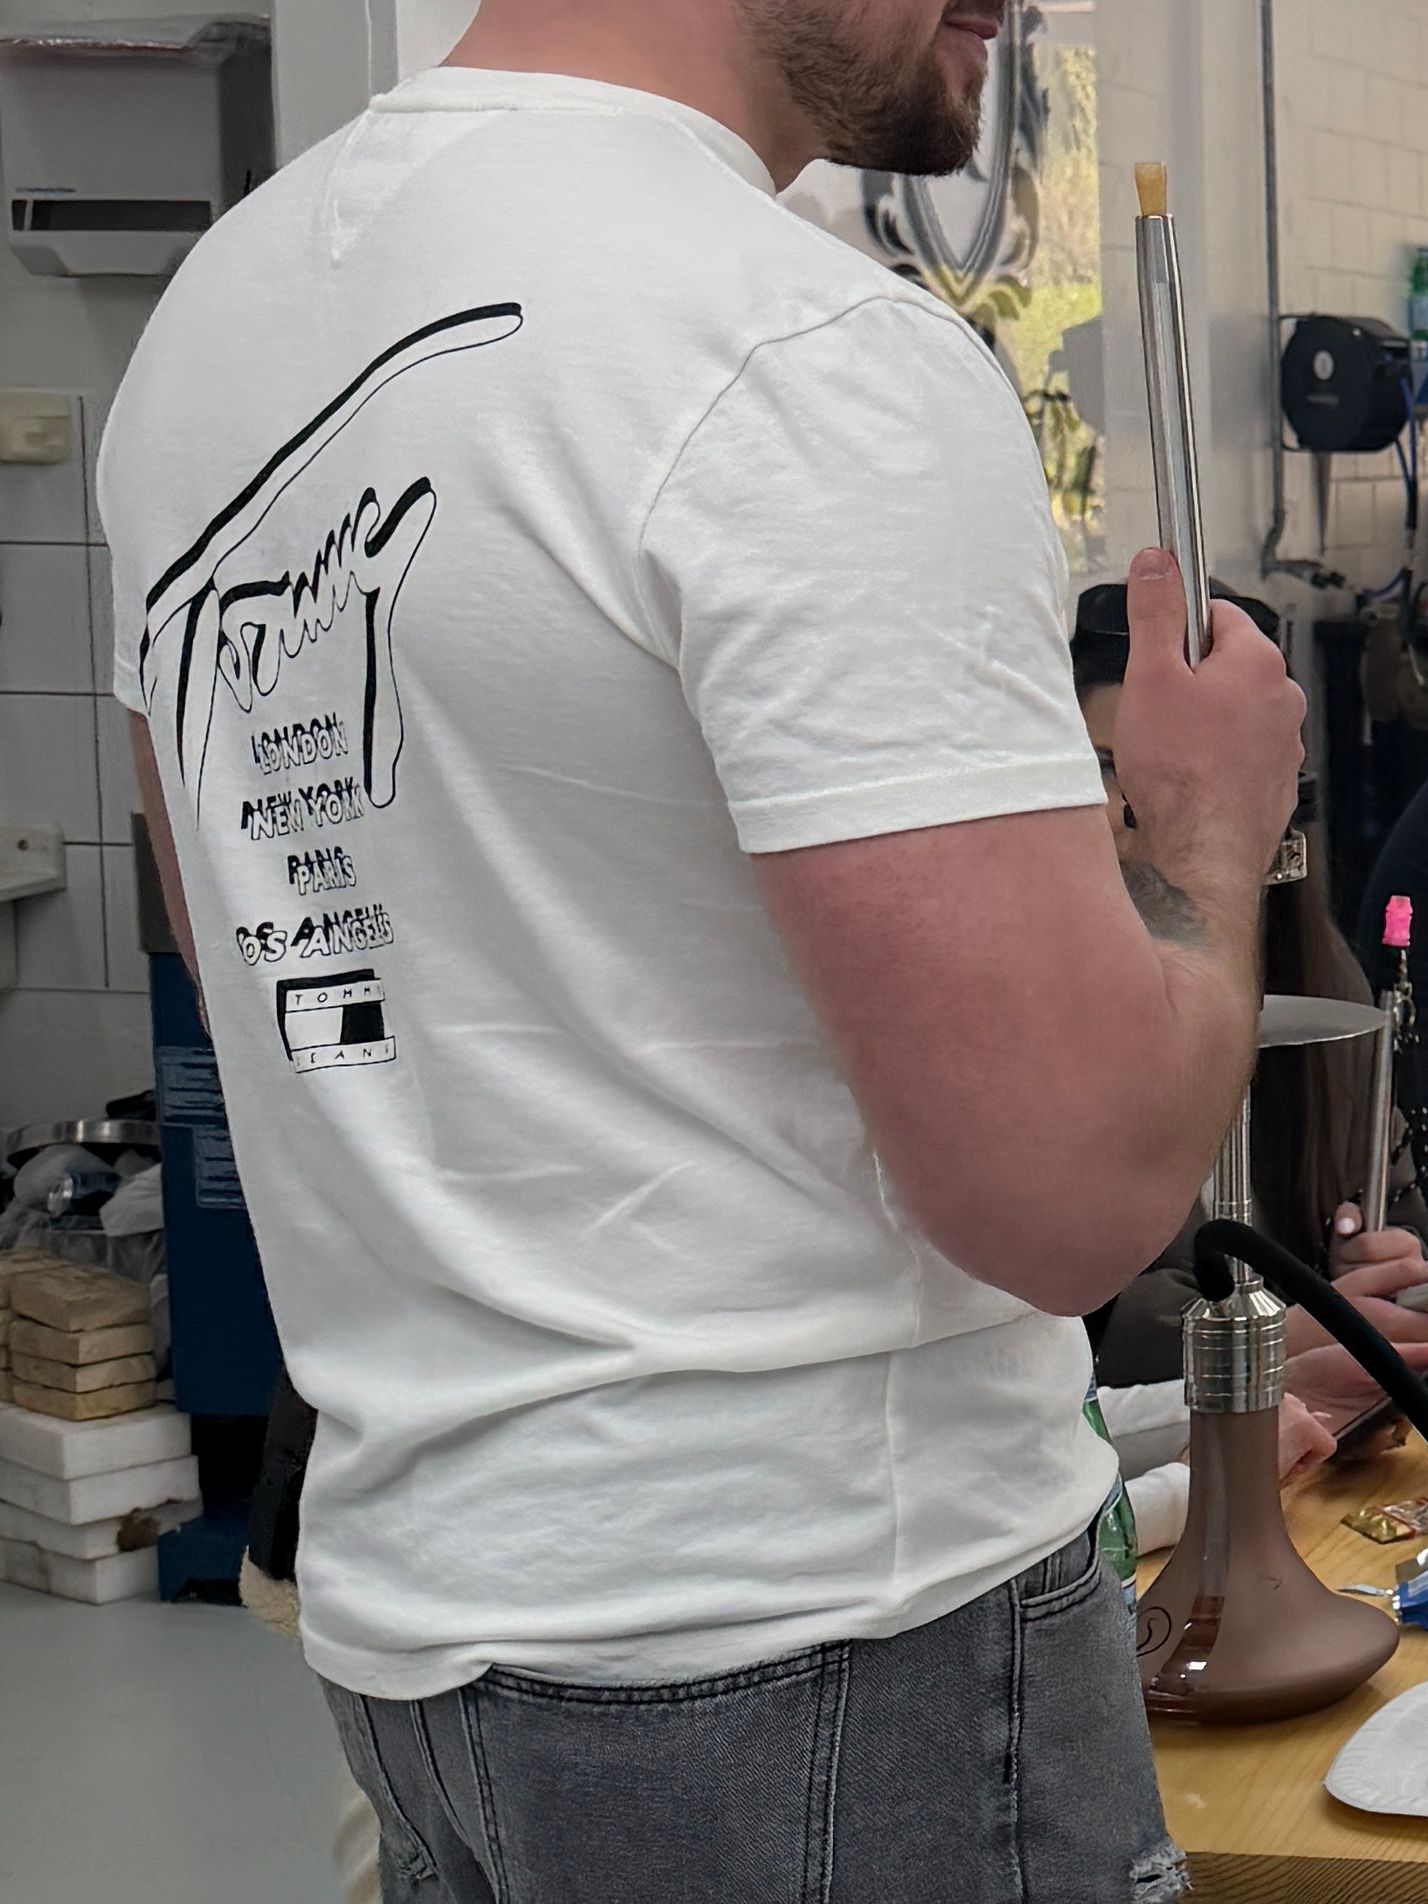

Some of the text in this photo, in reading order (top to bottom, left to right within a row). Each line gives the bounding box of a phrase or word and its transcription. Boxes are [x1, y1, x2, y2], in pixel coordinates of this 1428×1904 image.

[252, 712, 349, 775] LONDON
[241, 776, 364, 841] NEW YORK
[287, 846, 357, 896] PARIS
[236, 922, 287, 966] OS
